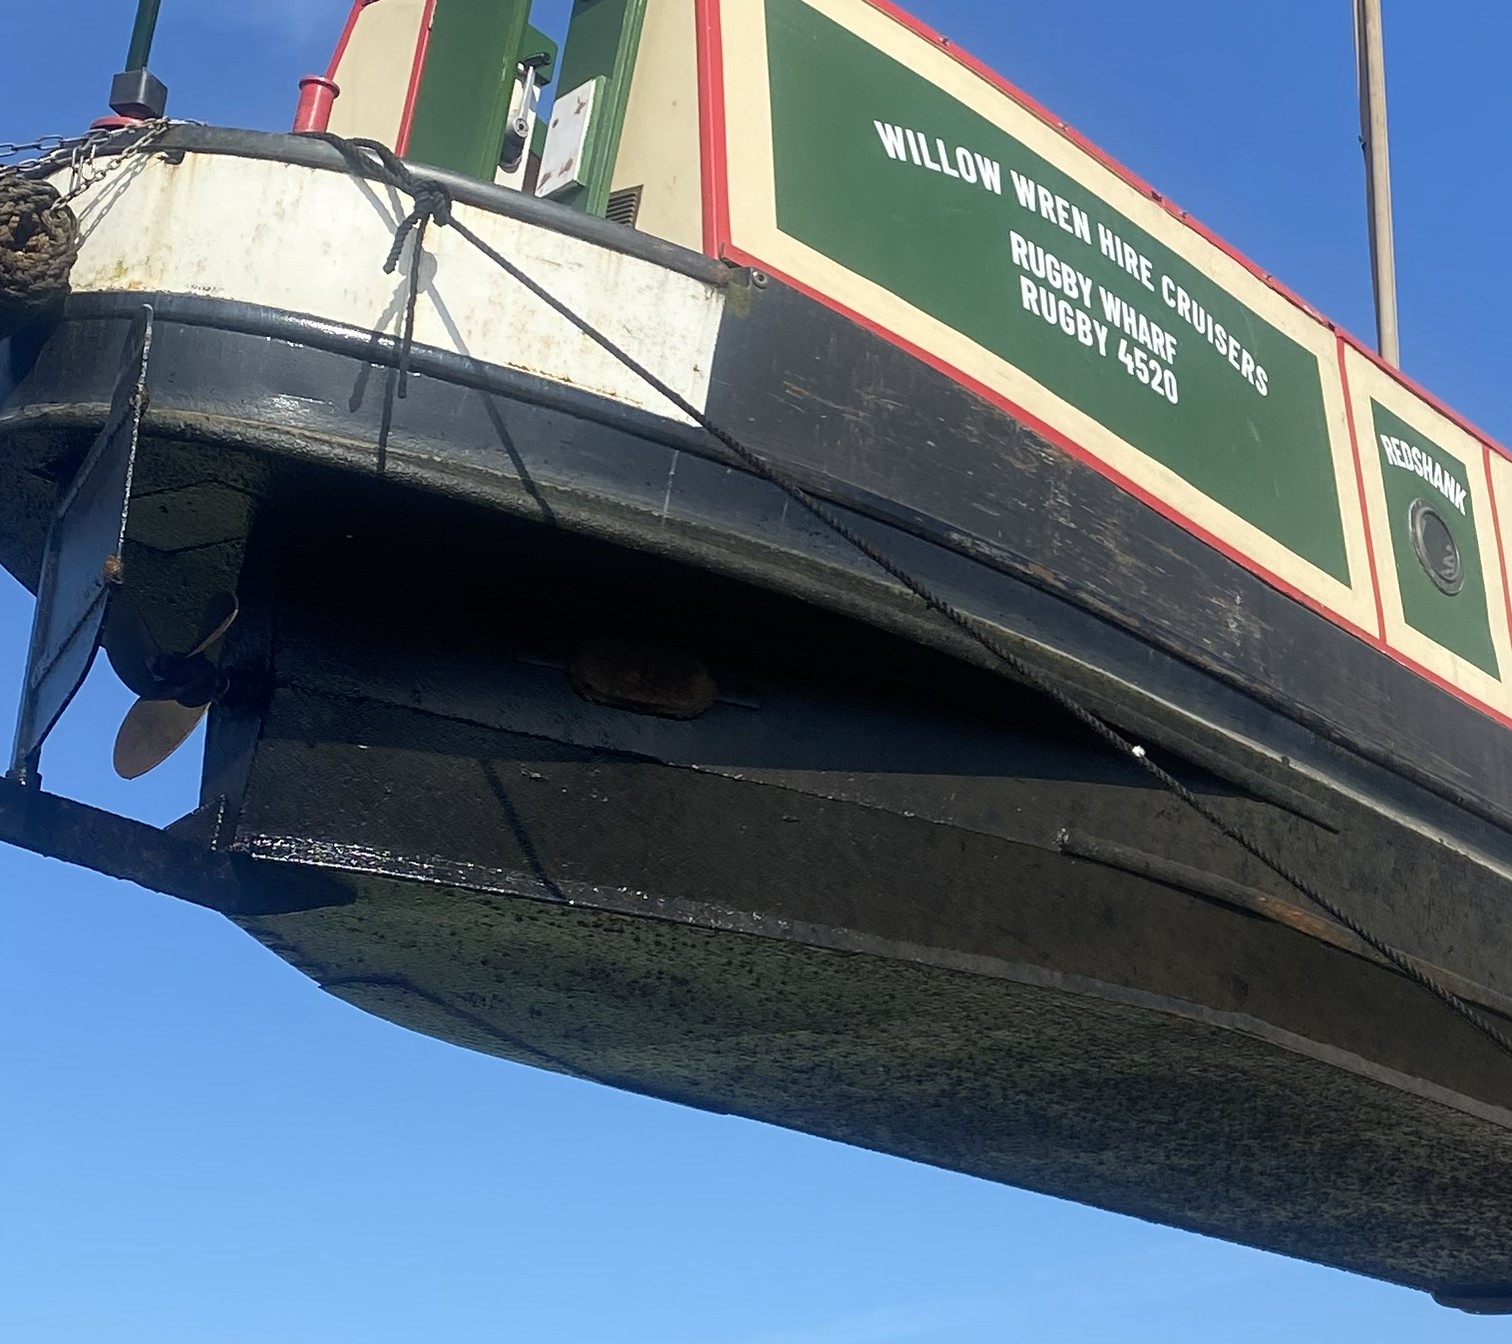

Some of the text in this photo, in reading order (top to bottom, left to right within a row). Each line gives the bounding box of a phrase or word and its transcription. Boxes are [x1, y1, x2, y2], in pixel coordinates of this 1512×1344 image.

[873, 120, 1269, 398] WILLOW WREN HIRE CRUISERS
[1010, 230, 1178, 365] RUGBY WHARF
[1020, 275, 1180, 404] RUGBY 4520
[1379, 433, 1468, 516] REDSHANK
